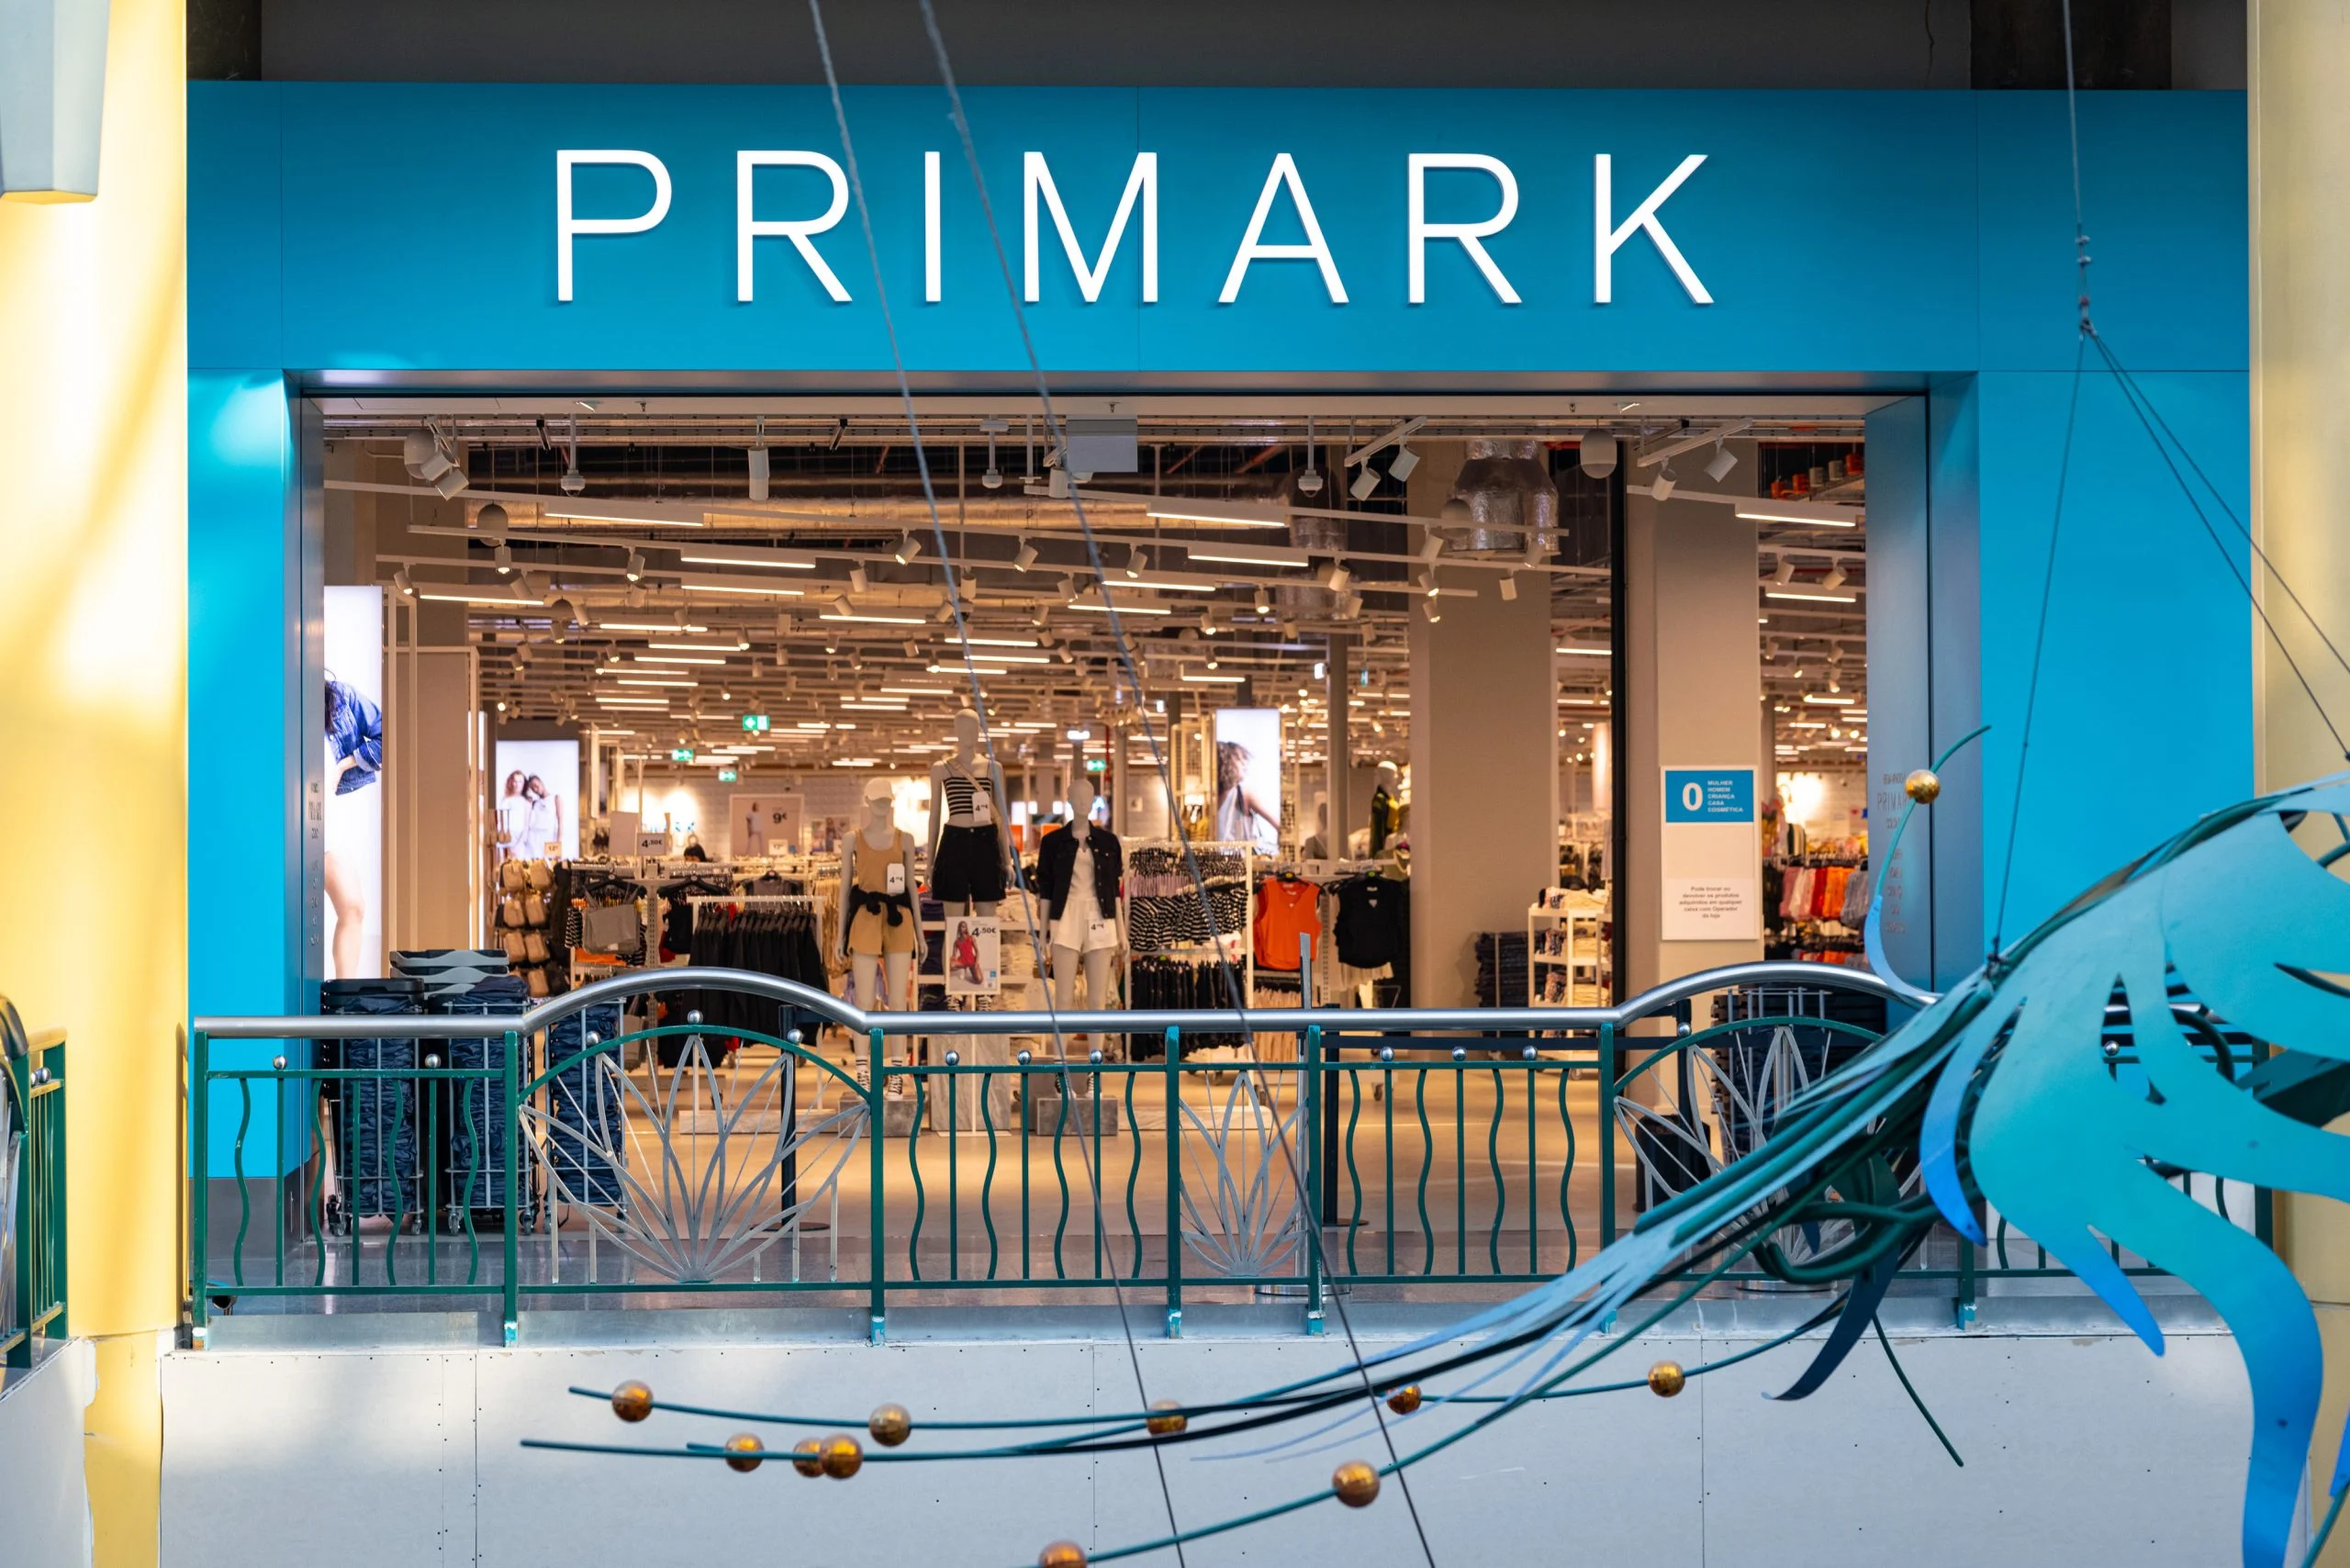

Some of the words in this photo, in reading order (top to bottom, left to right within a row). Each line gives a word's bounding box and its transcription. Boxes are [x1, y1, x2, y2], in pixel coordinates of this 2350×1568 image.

[556, 150, 1715, 304] PRIMARK
[1682, 782, 1704, 812] 0
[972, 927, 997, 937] 4.50€
